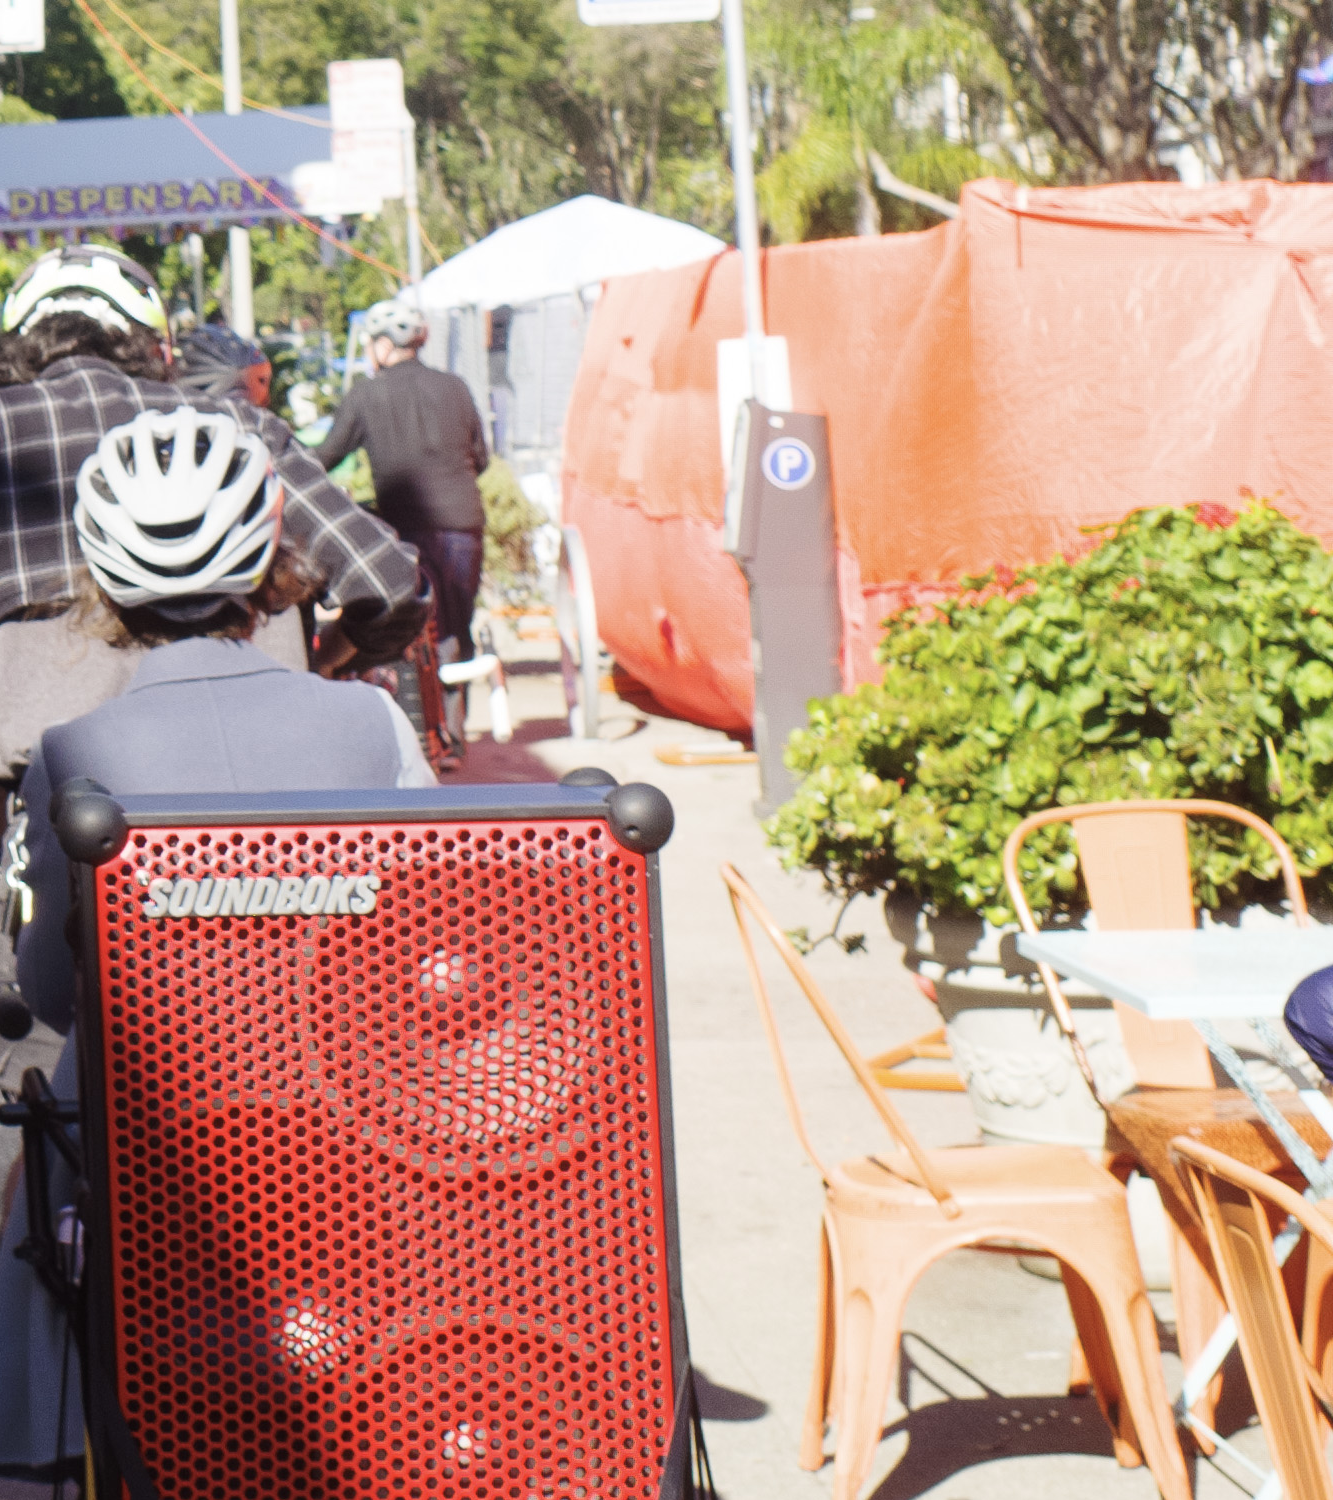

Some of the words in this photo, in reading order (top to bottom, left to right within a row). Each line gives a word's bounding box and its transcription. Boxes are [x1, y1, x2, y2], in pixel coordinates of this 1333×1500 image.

[9, 177, 271, 217] DISPENSARY
[777, 446, 803, 481] P
[144, 874, 381, 918] SOUNDBOKS
